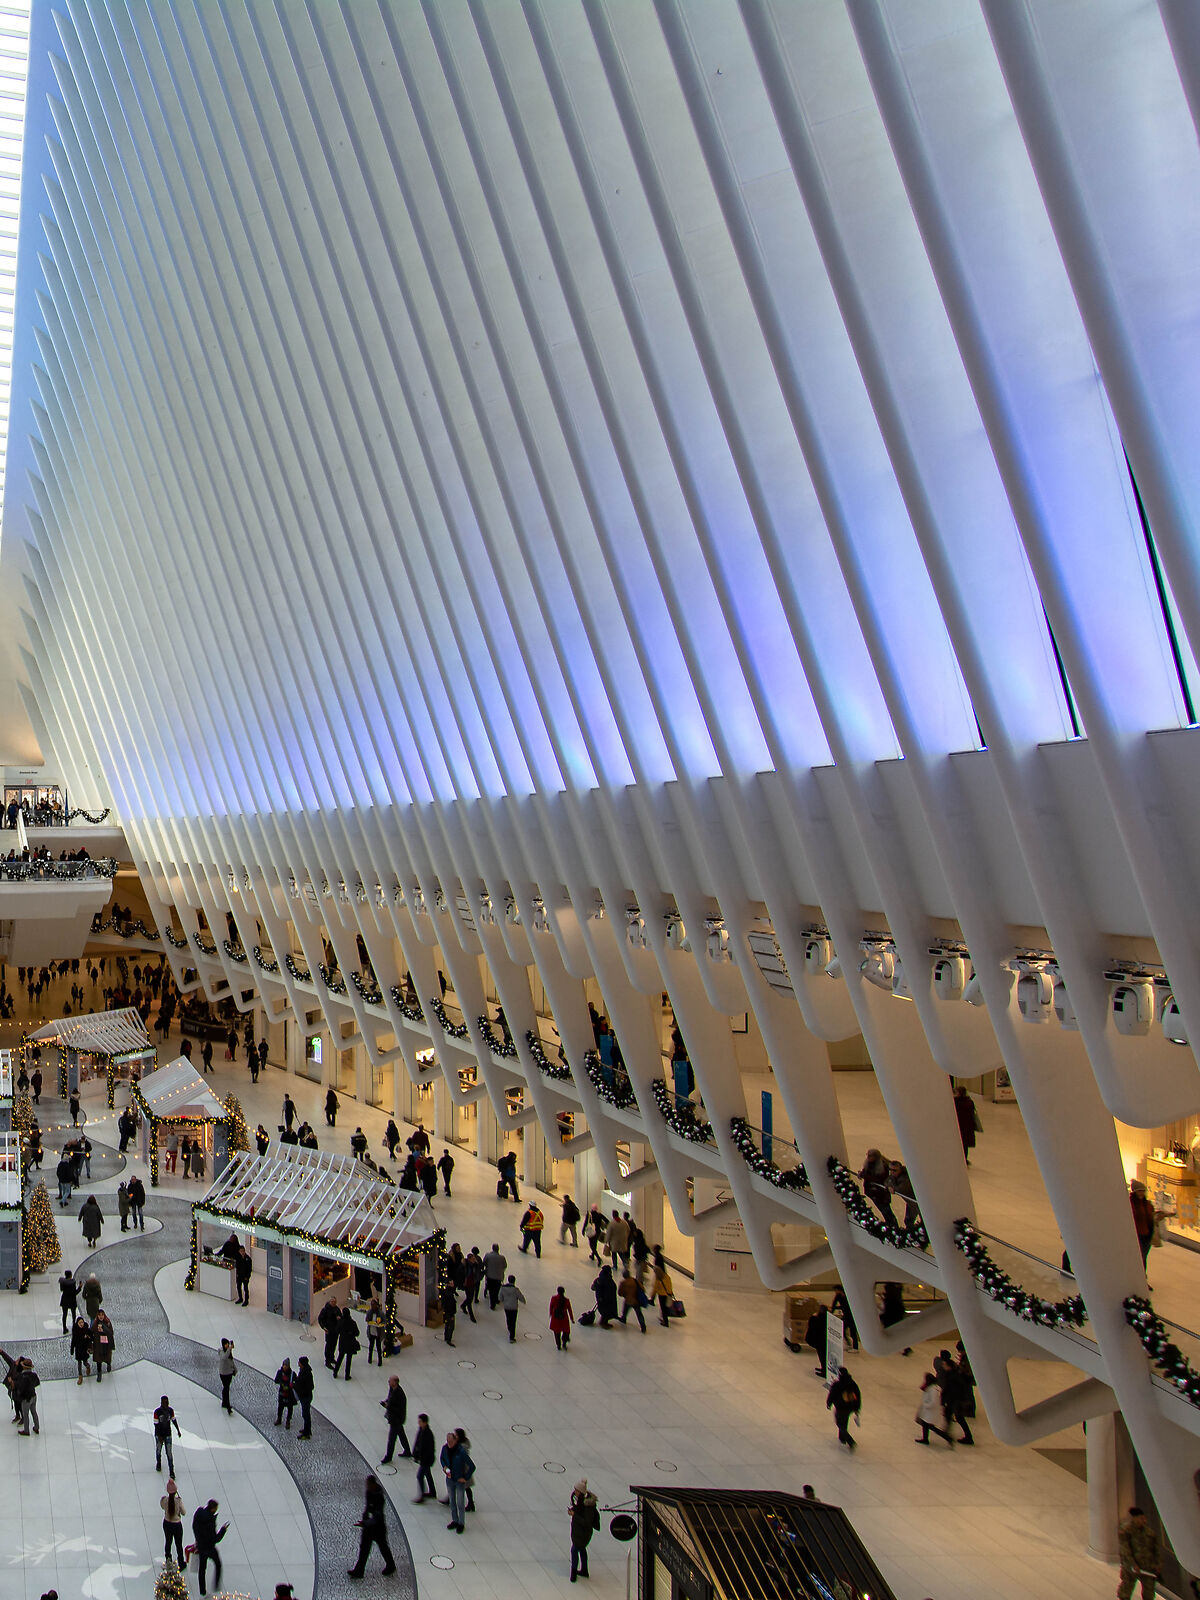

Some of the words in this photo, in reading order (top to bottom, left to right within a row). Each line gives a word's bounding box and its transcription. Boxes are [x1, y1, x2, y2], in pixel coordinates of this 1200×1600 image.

[219, 1217, 256, 1234] SNACKCRATE
[295, 1239, 306, 1248] NO
[306, 1242, 337, 1257] CHEWING
[336, 1251, 370, 1267] ALLOWED!
